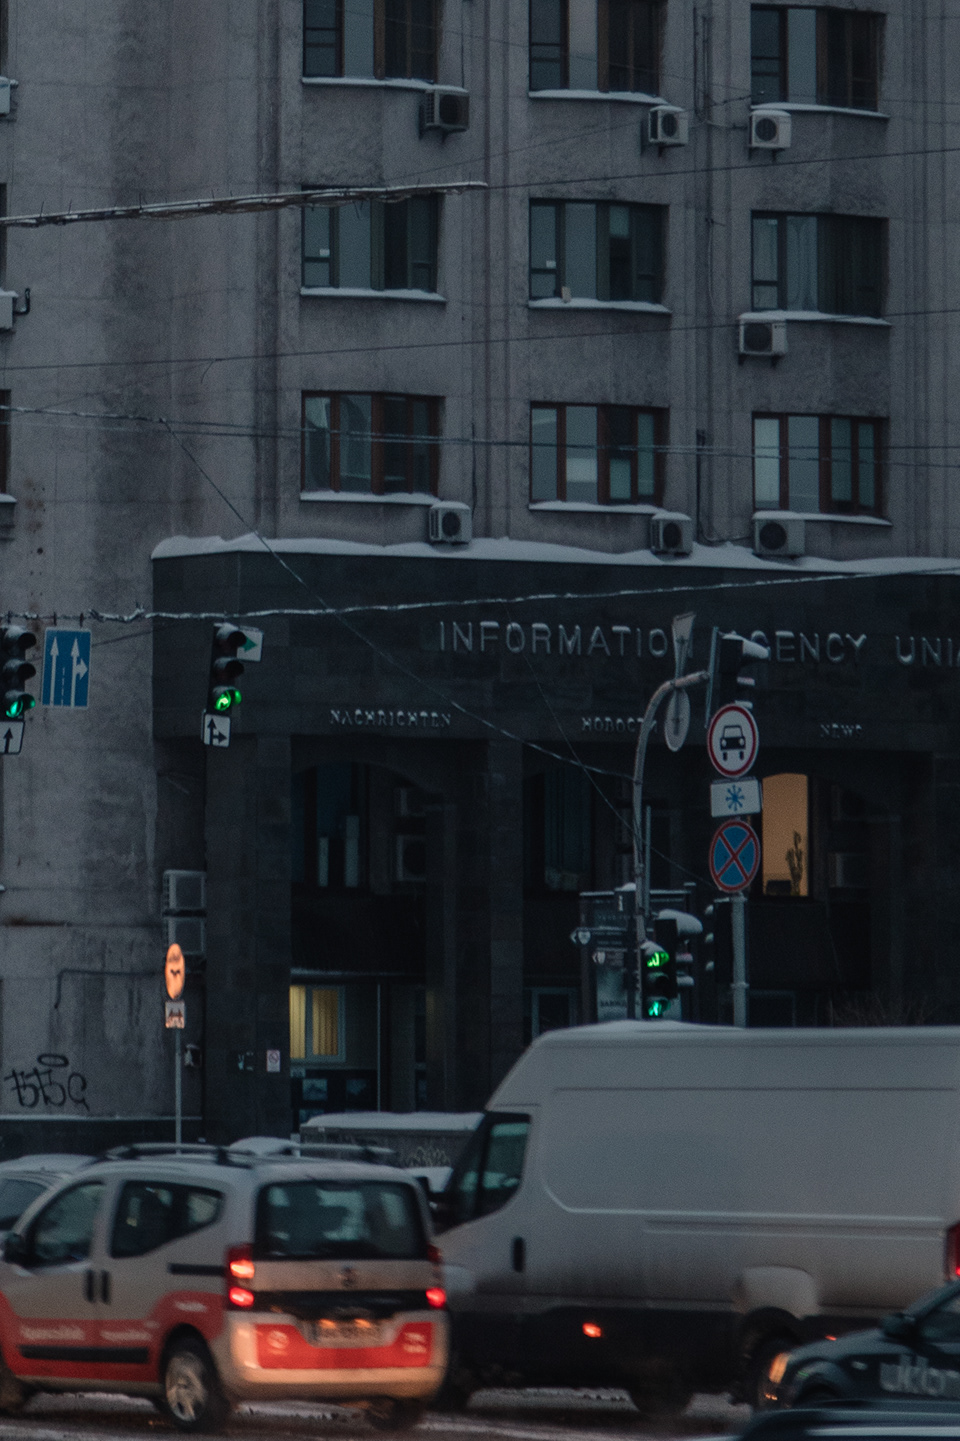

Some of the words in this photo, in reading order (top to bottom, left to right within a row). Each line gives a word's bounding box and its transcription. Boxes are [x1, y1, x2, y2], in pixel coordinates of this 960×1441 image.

[438, 620, 693, 659] INFORMATIO
[895, 635, 960, 668] UNI
[329, 708, 452, 728] NACHRICHTEN
